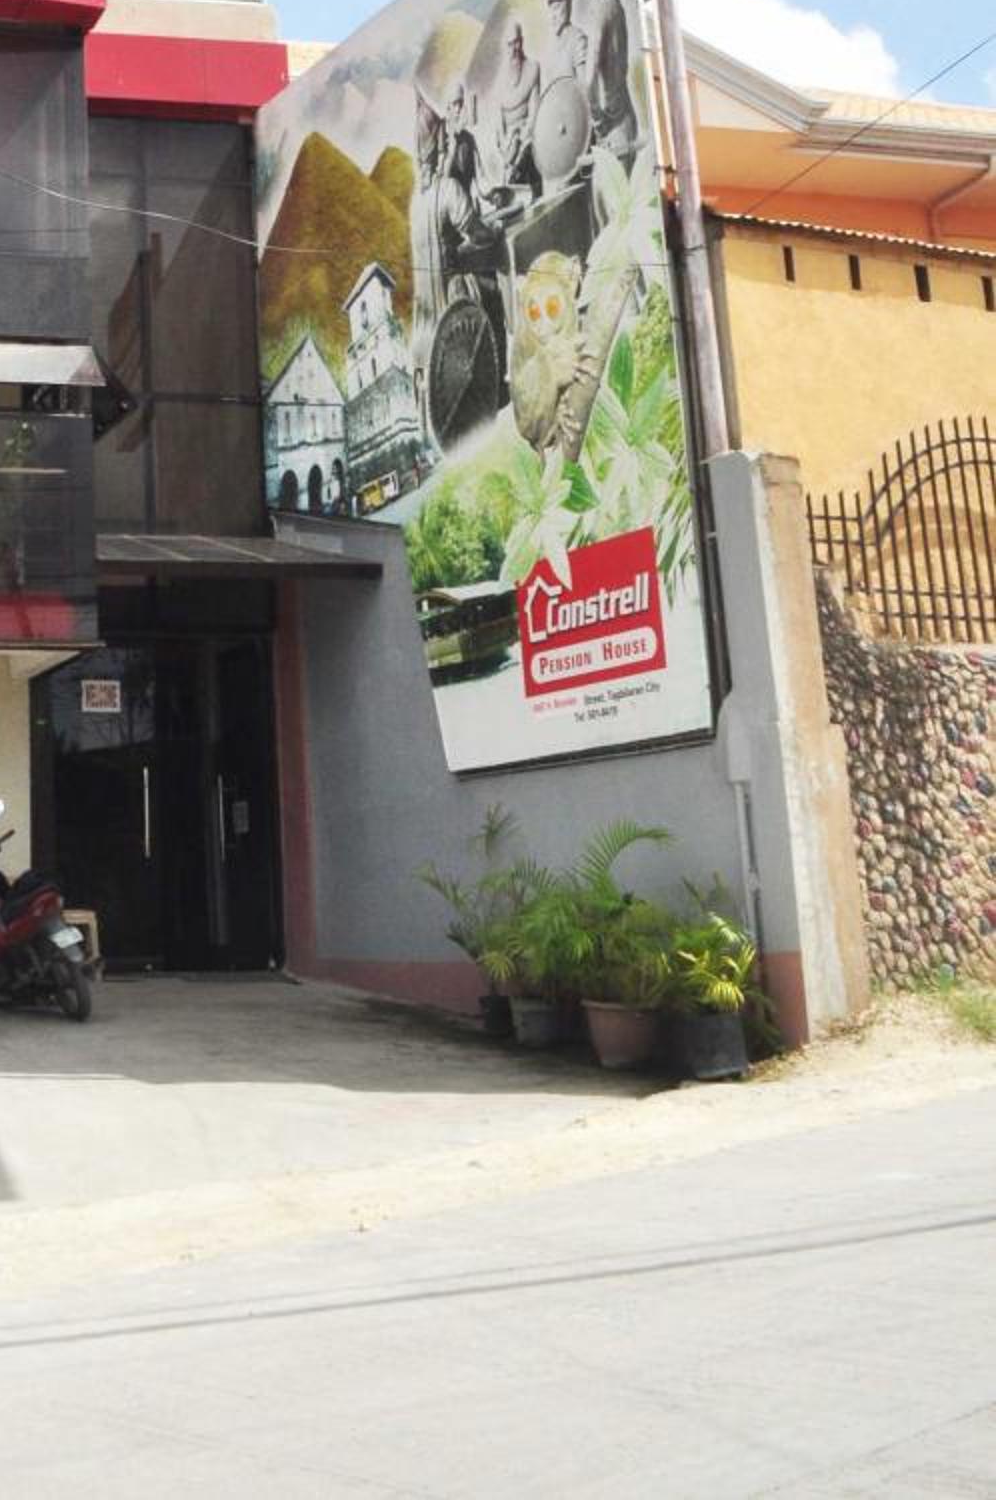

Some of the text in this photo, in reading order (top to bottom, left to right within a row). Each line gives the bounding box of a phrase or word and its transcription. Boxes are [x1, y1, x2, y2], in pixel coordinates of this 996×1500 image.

[545, 571, 650, 635] Constrell
[539, 637, 648, 677] PENSION HOUSE
